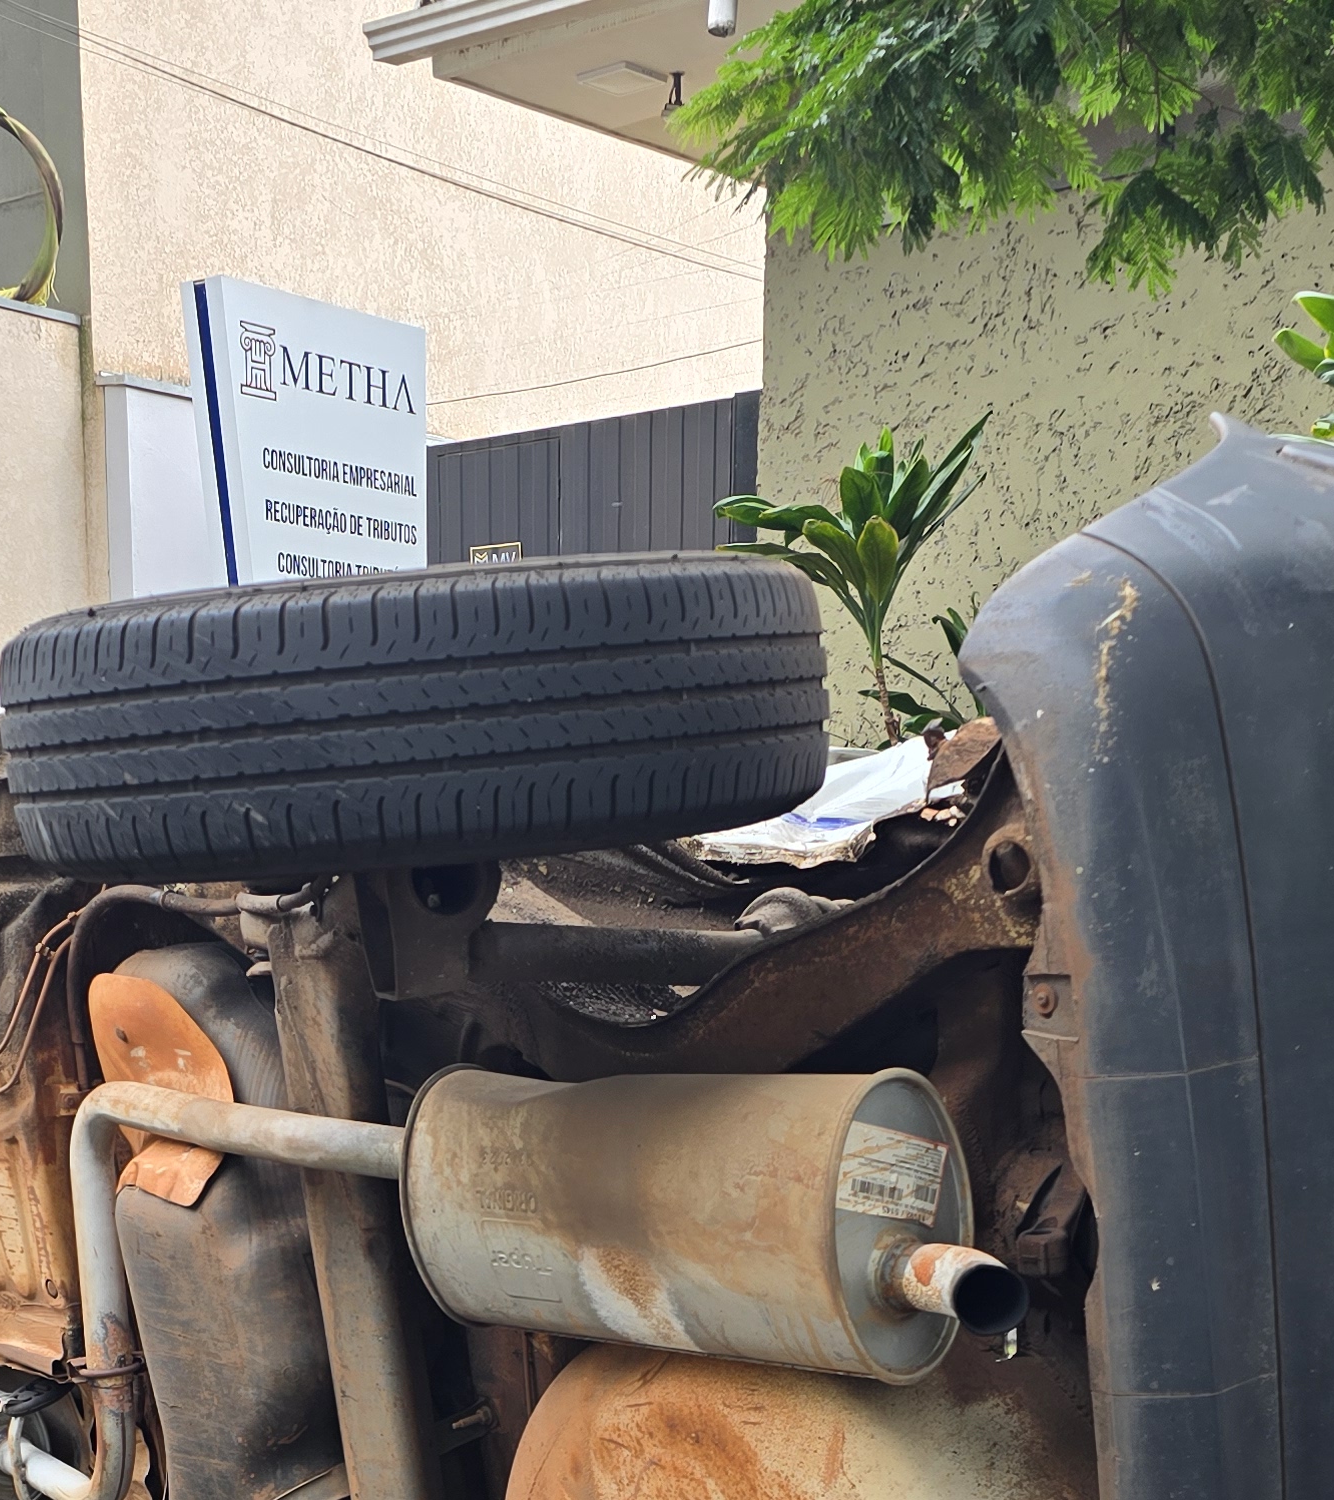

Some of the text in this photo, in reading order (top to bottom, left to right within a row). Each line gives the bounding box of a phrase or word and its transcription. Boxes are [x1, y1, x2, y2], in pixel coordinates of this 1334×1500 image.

[279, 344, 417, 415] METHA
[262, 447, 417, 497] CONSULTORIA EMPRESARIAL
[265, 498, 417, 545] RECUPERAÇÃO DE TRIBUTOS
[277, 551, 354, 579] CONSULTORIA
